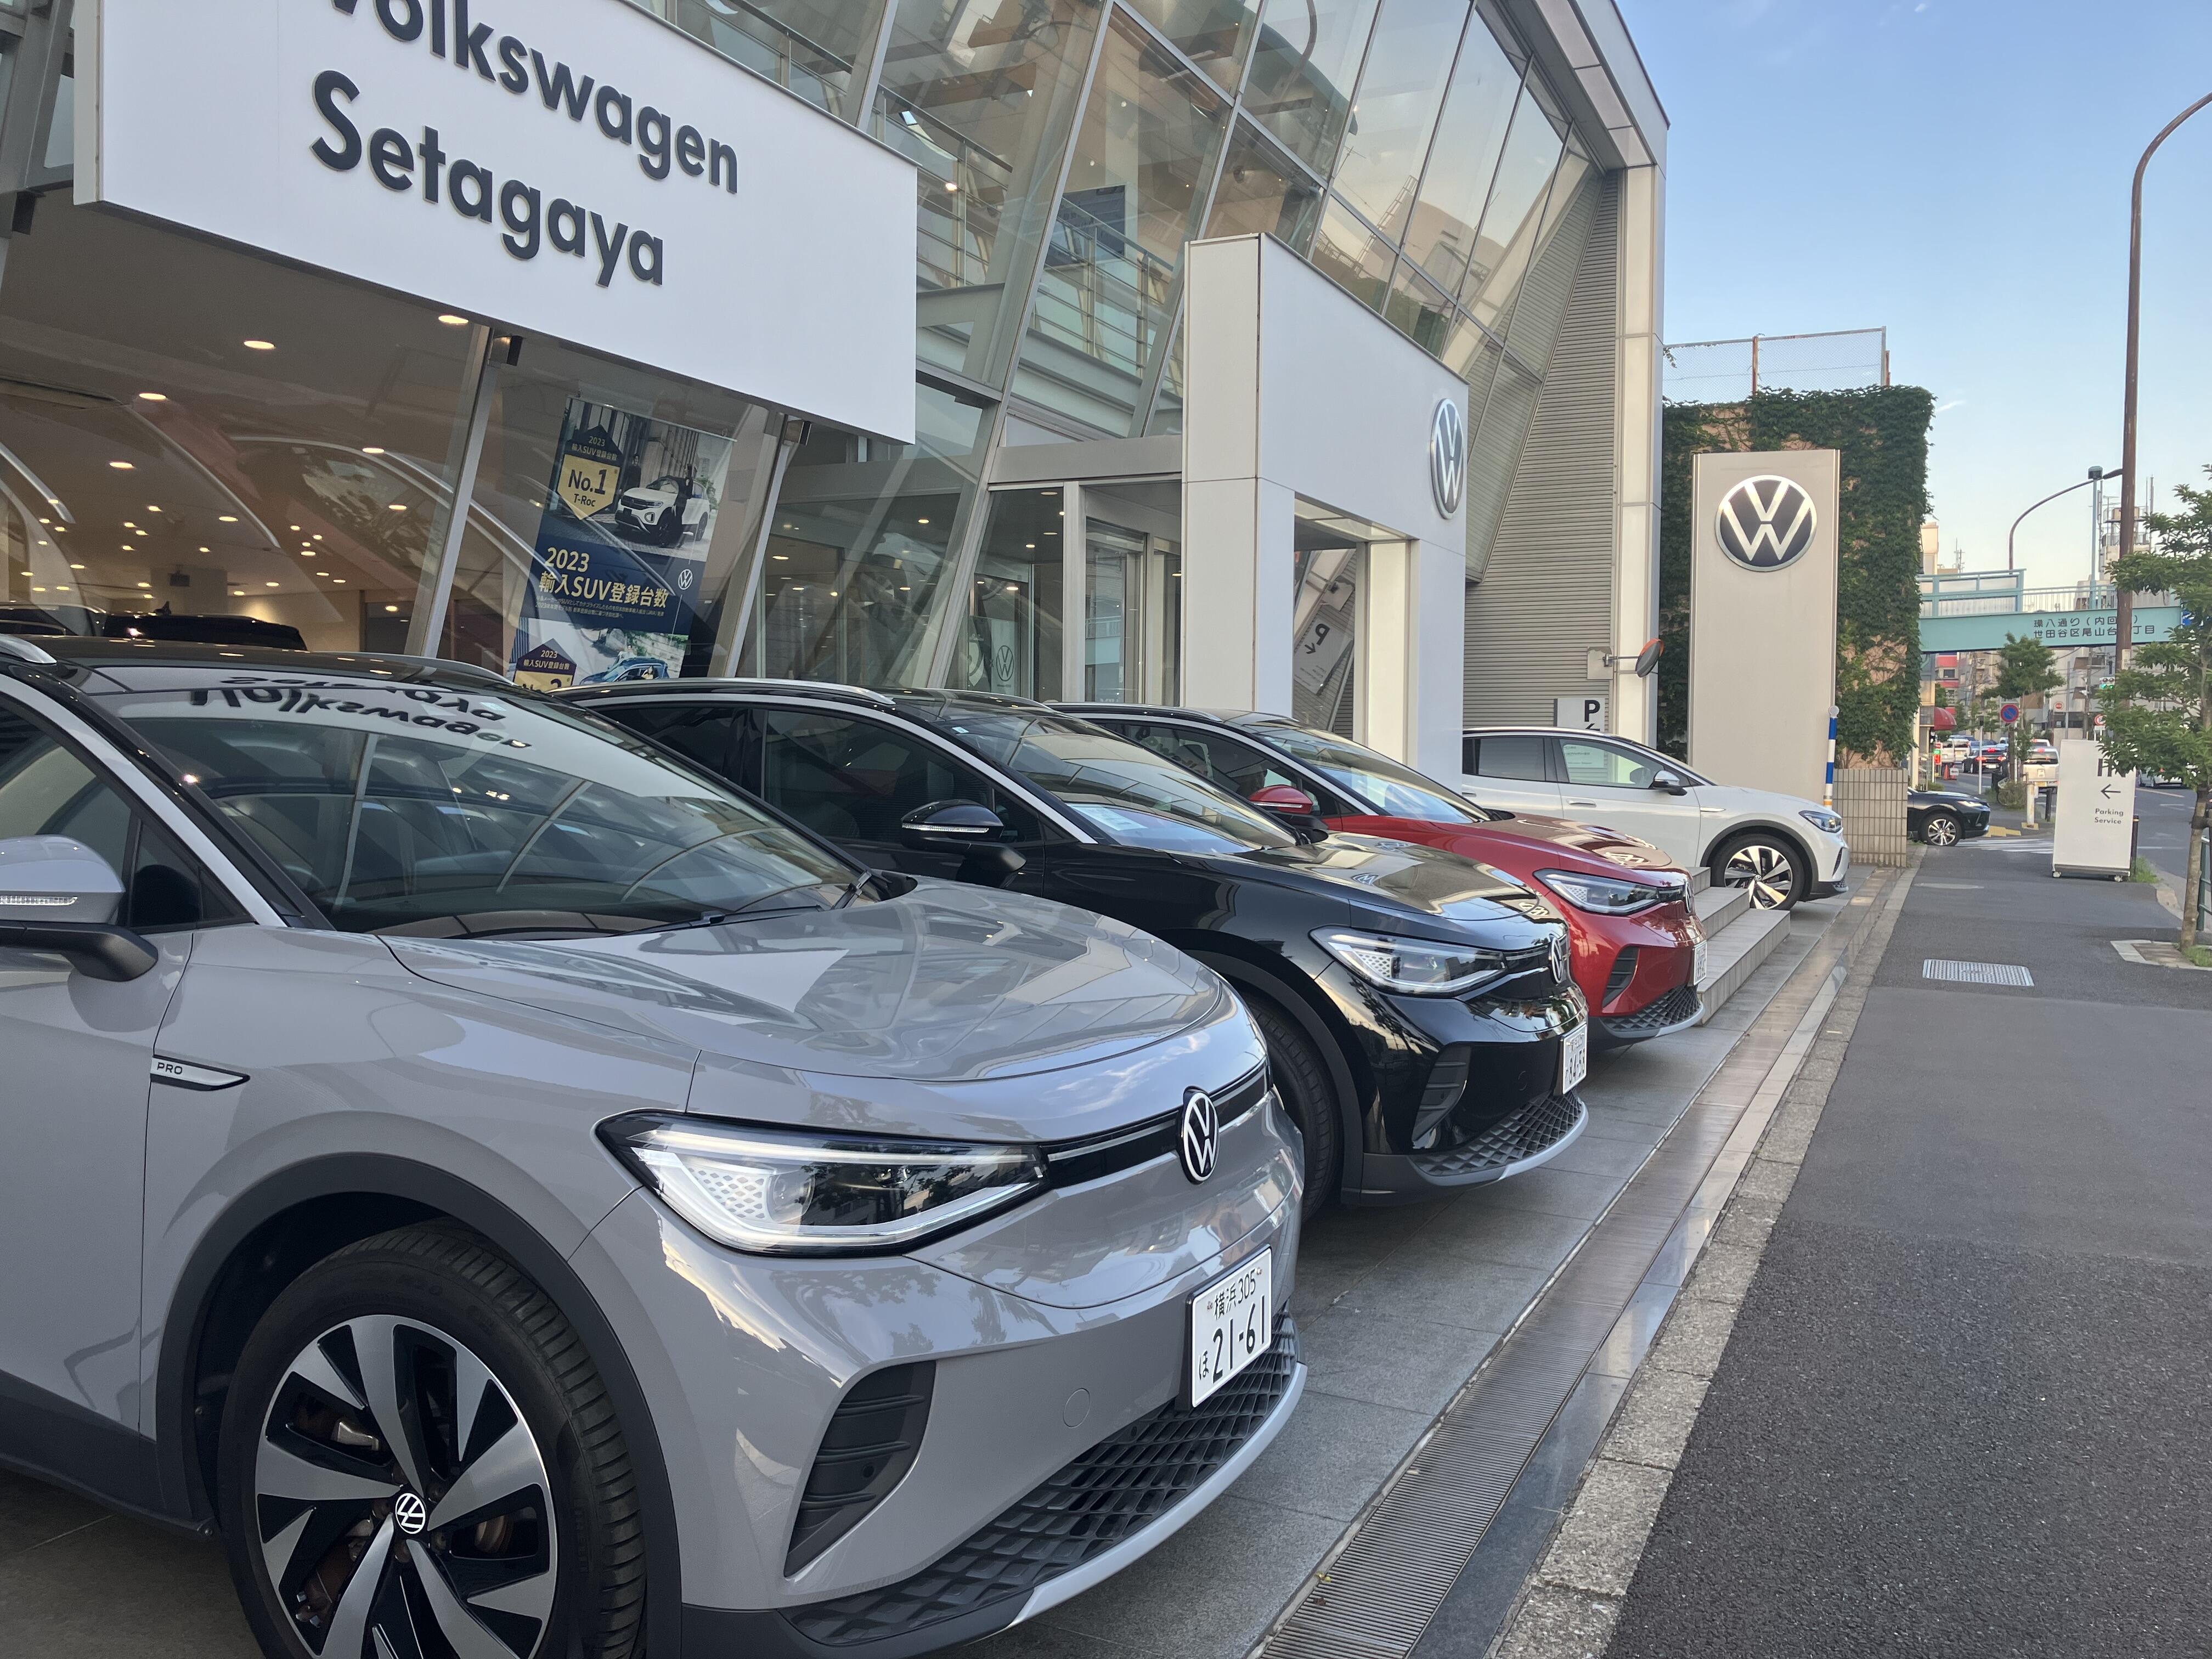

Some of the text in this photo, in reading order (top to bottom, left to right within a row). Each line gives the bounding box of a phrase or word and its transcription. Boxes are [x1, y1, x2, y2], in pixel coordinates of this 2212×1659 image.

[330, 0, 738, 194] olkswagen
[311, 70, 663, 287] Setagaya
[589, 436, 606, 447] 2023
[572, 443, 618, 461] 輸入SUV登録台数
[568, 469, 607, 495] No.1
[574, 493, 596, 507] T-Roc
[544, 547, 590, 573] 2023
[538, 571, 670, 609] 輸入SUV登録台数
[2034, 614, 2138, 628] 環八通り（内回）
[2034, 625, 2155, 638] 世田谷区尾山台丁目
[541, 650, 558, 658] 2023
[523, 659, 570, 670] 輸入SUV登録台数
[1584, 699, 1600, 722] P
[2095, 808, 2124, 817] Parking
[157, 1062, 183, 1075] PRO
[1199, 1295, 1265, 1384] ほ 21-61
